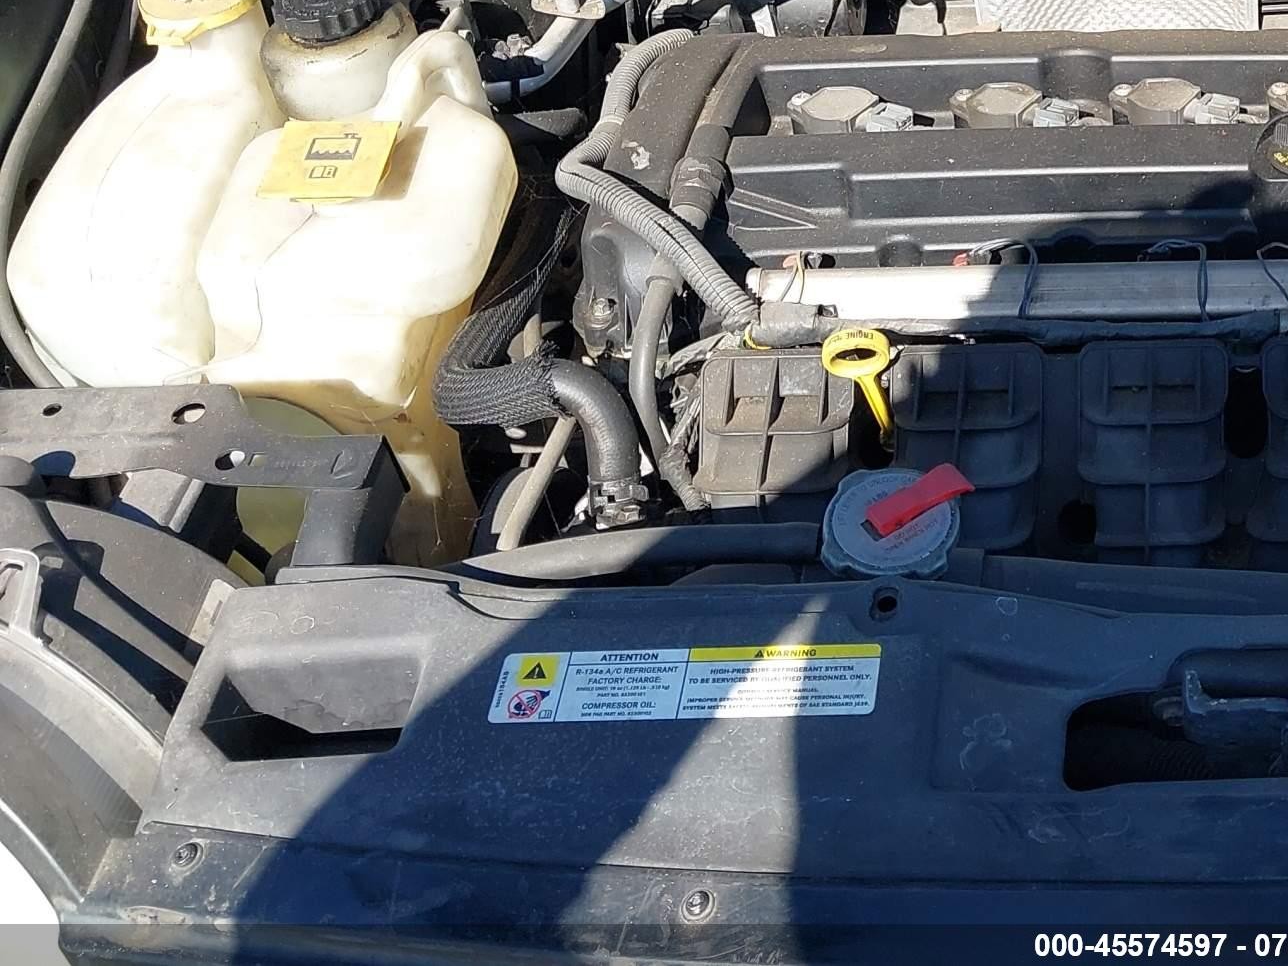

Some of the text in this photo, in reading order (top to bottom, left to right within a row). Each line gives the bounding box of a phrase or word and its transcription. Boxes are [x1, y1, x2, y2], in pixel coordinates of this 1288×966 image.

[1273, 152, 1288, 163] SAE
[846, 330, 874, 340] ENGINE
[600, 653, 658, 662] ATTENTION
[766, 649, 817, 657] WARNING
[576, 666, 679, 676] R-134a A/C REFRIGERANT
[710, 666, 770, 675] HIGH-PRESSURE
[587, 677, 624, 685] FACTORY
[711, 676, 749, 684] SERVICED
[803, 674, 849, 682] PERSONNEL
[849, 673, 872, 681] ONLY.
[582, 701, 657, 710] COMPRESSOR OIL:
